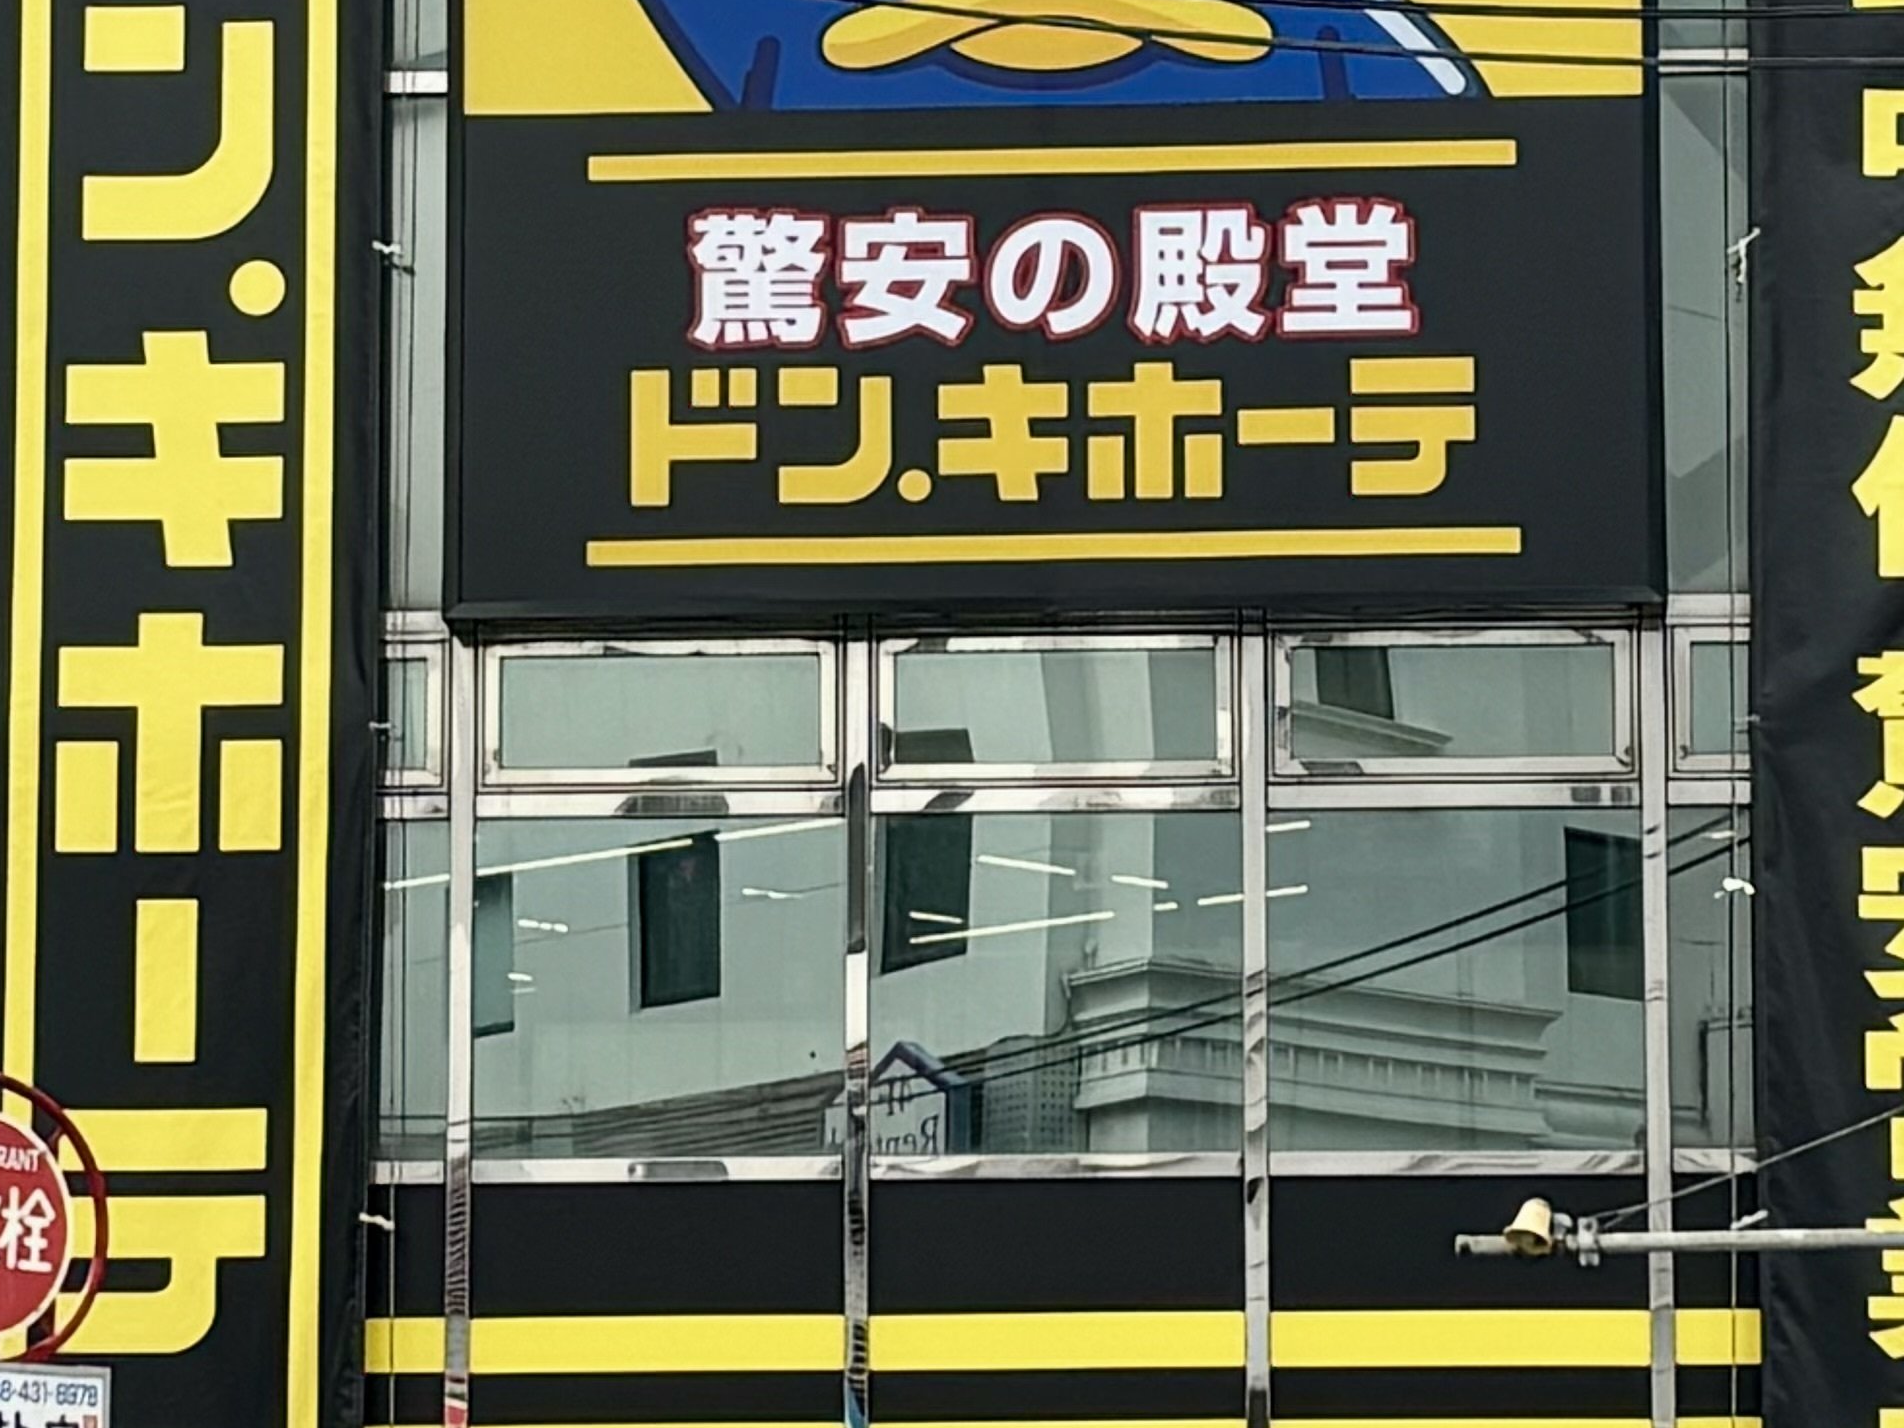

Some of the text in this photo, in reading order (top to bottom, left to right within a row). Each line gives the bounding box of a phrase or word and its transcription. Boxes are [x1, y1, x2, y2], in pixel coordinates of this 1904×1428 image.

[689, 201, 1418, 350] 驚安の殿堂
